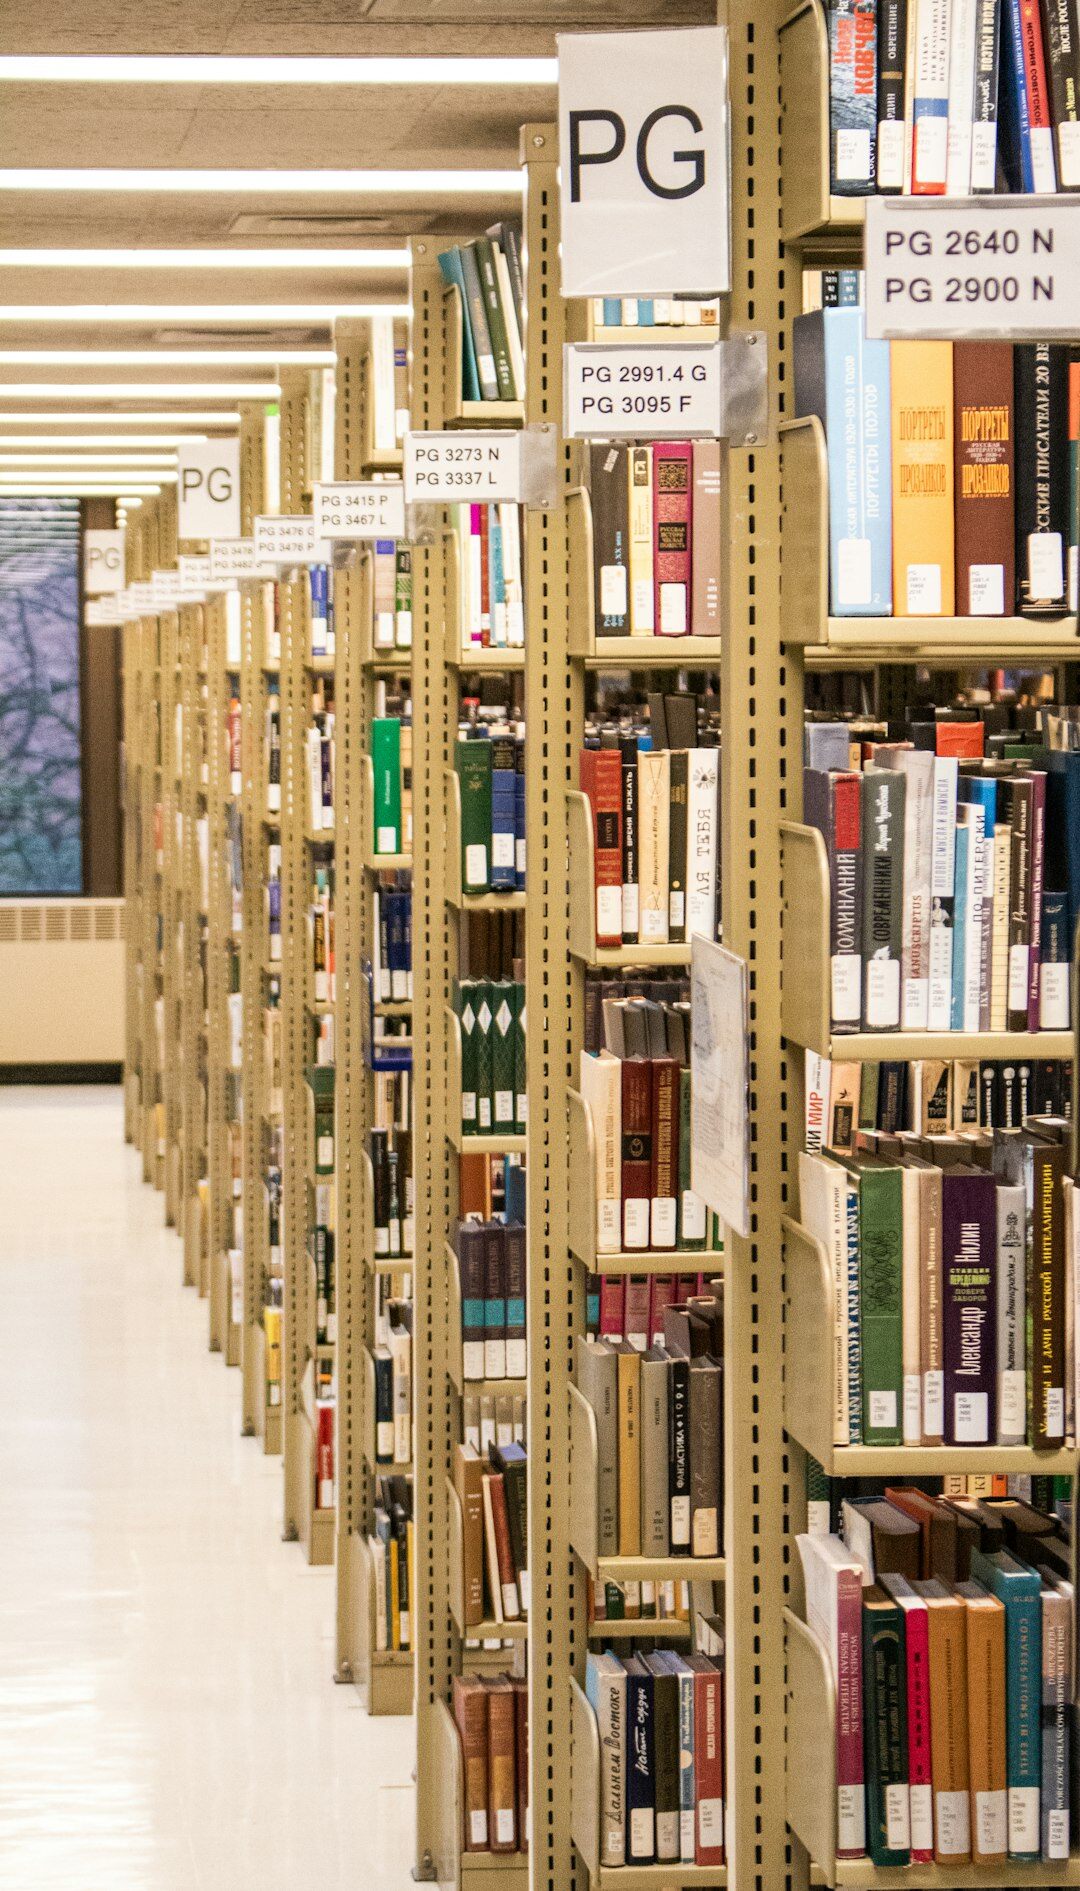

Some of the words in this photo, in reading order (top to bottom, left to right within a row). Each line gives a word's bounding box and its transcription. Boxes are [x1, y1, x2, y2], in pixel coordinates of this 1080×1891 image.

[886, 3, 898, 60] ОБРЕТЕНИЕ
[981, 26, 994, 34] И
[1025, 22, 1036, 66] ИСТОРИЯ
[1059, 24, 1072, 54] ПОСЛЕ
[980, 34, 994, 72] ПОЭТЫ
[1030, 68, 1042, 125] СОВЕТСКОЙ
[569, 104, 706, 204] PG
[885, 230, 932, 256] PG
[944, 229, 1019, 255] 2640
[1031, 228, 1054, 253] N
[885, 277, 932, 303] PG
[944, 276, 1019, 303] 2900
[1031, 275, 1054, 301] N
[1034, 343, 1049, 363] ВЕ
[581, 366, 612, 383] PG
[619, 365, 684, 382] 2991.4
[691, 365, 707, 381] G
[1035, 366, 1049, 385] 20
[582, 396, 613, 414] PG
[622, 396, 672, 414] 3095
[679, 395, 692, 413] F
[864, 384, 879, 438] ПОЭТОВ
[899, 410, 946, 441] ПОРТРЕТЫ
[961, 410, 1009, 442] ПОРТРЕТЫ
[1035, 388, 1050, 479] ПИСАТЕЛИ
[415, 448, 439, 462] PG
[445, 448, 482, 462] 3273
[488, 447, 500, 461] N
[182, 466, 232, 503] PG
[415, 472, 439, 486] PG
[445, 472, 482, 485] 3337
[488, 471, 497, 485] L
[865, 444, 880, 518] ПОРТРЕТЫ
[961, 464, 1009, 494] ПРОЗАИКОВ
[321, 495, 341, 506] PG
[345, 495, 375, 506] 3415
[379, 495, 388, 505] P
[1035, 483, 1050, 533] ССКИЕ
[259, 526, 275, 536] PG
[321, 514, 341, 526] PG
[345, 514, 375, 525] 3467
[380, 514, 386, 525] L
[846, 507, 857, 540] ССКАЯ
[89, 547, 120, 570] PG
[259, 542, 275, 552] PG
[626, 771, 634, 811] РОЖАТЬ
[937, 778, 949, 816] ВЫМЫСЛА
[626, 816, 634, 847] ВРЕМЯ
[697, 808, 711, 857] ТЕБЯ
[936, 827, 948, 858] СМЫСЛА
[873, 855, 892, 942] СОВРЕМЕННИКИ
[1032, 882, 1041, 892] XX
[1011, 889, 1028, 922] Русские
[910, 895, 923, 979] ANUSCRIPTUS
[1032, 922, 1041, 948] Русские
[807, 1092, 823, 1126] МИР
[1041, 1163, 1053, 1265] ИНТЕЛЛИГЕНЦИИ
[954, 1222, 981, 1262] Нилин
[835, 1288, 843, 1323] РУССКИЕ
[1040, 1271, 1053, 1322] РУССКОЙ
[929, 1313, 938, 1371] ературные
[954, 1306, 988, 1376] Александр
[1042, 1365, 1053, 1374] И
[675, 1429, 685, 1489] ФАНТАСТИКА
[839, 1631, 850, 1675] RUSSIAN
[849, 1635, 859, 1675] WOMEN
[1019, 1617, 1029, 1719] CONVERSATIONS
[839, 1677, 850, 1737] LITERATURE
[849, 1677, 859, 1719] WRITERS
[603, 1686, 621, 1750] Востоке
[851, 1722, 859, 1733] IN
[1019, 1742, 1029, 1776] EXILE
[604, 1753, 623, 1825] Дальнем
